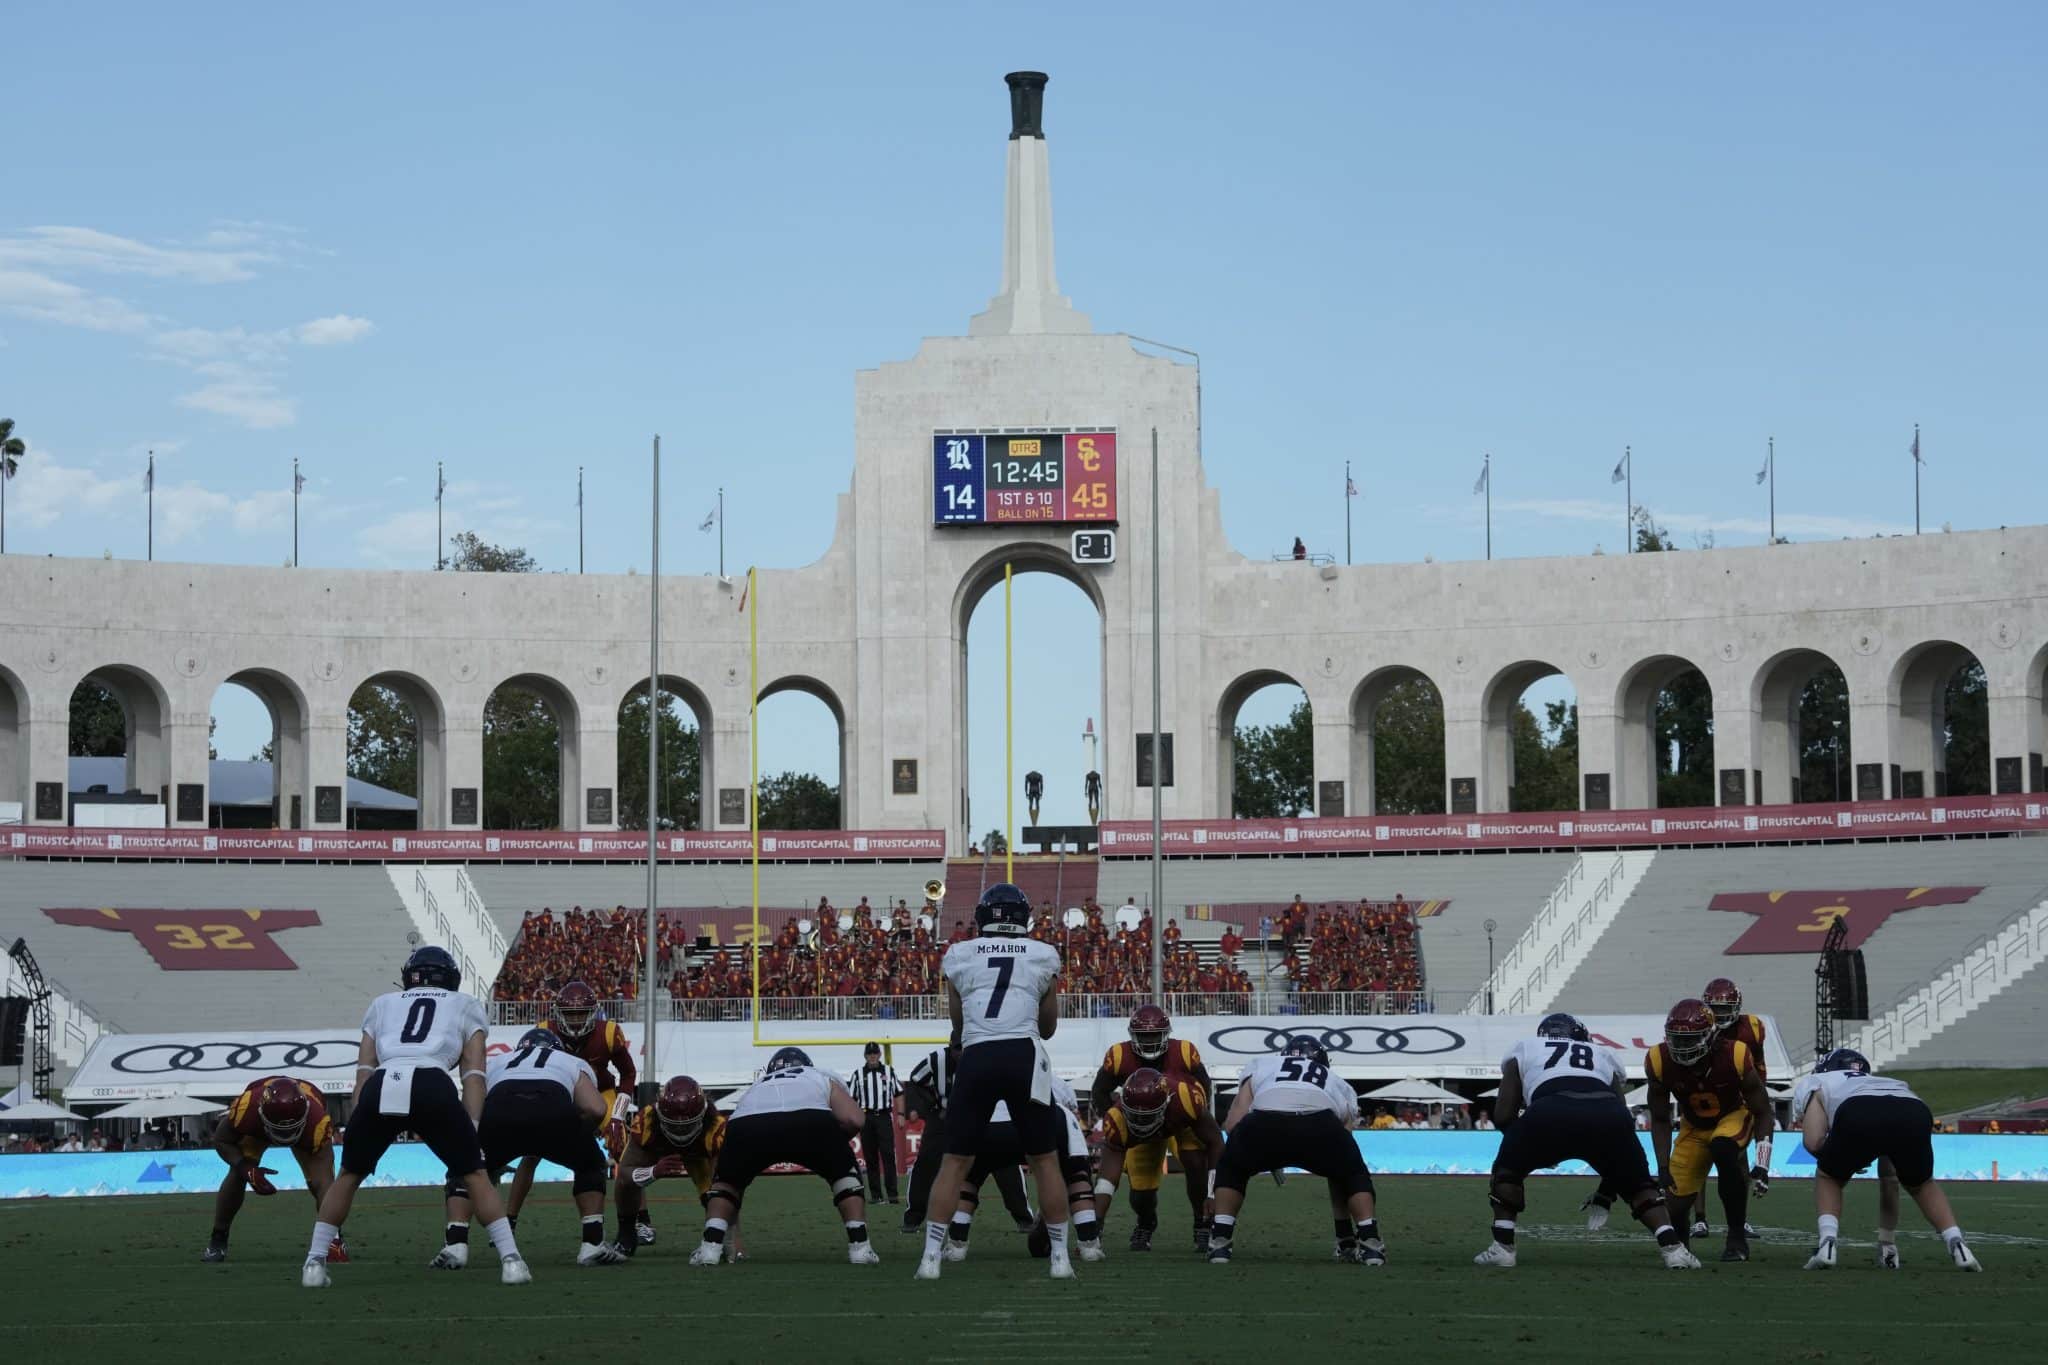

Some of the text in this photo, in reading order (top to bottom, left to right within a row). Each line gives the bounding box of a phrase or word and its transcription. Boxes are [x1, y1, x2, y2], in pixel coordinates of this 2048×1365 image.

[946, 439, 973, 470] R
[992, 461, 1058, 482] 12:45
[943, 484, 976, 510] 14
[997, 492, 1053, 505] 1ST & 10
[1071, 483, 1108, 508] 45
[997, 506, 1055, 519] BALL ON 15
[1852, 812, 1928, 824] ITRUSTCAPITAL
[1946, 807, 2022, 819] ITRUSTCAPITAL
[1666, 818, 1740, 830] ITRUSTCAPITAL
[1759, 815, 1834, 827] ITRUSTCAPITAL
[1299, 828, 1373, 839] ITRUSTCAPITAL
[1390, 827, 1463, 837] ITRUSTCAPITAL
[1482, 825, 1556, 835] ITRUSTCAPITAL
[1574, 823, 1648, 833] ITRUSTCAPITAL
[27, 835, 104, 847] ITRUSTCAPITAL
[1208, 831, 1281, 840] ITRUSTCAPITAL
[124, 837, 200, 848] ITRUSTCAPITAL
[219, 838, 295, 849] ITRUSTCAPITAL
[313, 839, 389, 849] ITRUSTCAPITAL
[407, 839, 482, 849] ITRUSTCAPITAL
[501, 839, 575, 850] ITRUSTCAPITAL
[777, 839, 851, 849] ITRUSTCAPITAL
[868, 838, 942, 849] ITRUSTCAPITAL
[154, 923, 256, 950] 32
[977, 944, 1027, 953] McMAHON
[984, 956, 1015, 1019] 7
[400, 998, 436, 1043] 0
[1543, 1041, 1594, 1071] 78
[1275, 1057, 1328, 1089] 58
